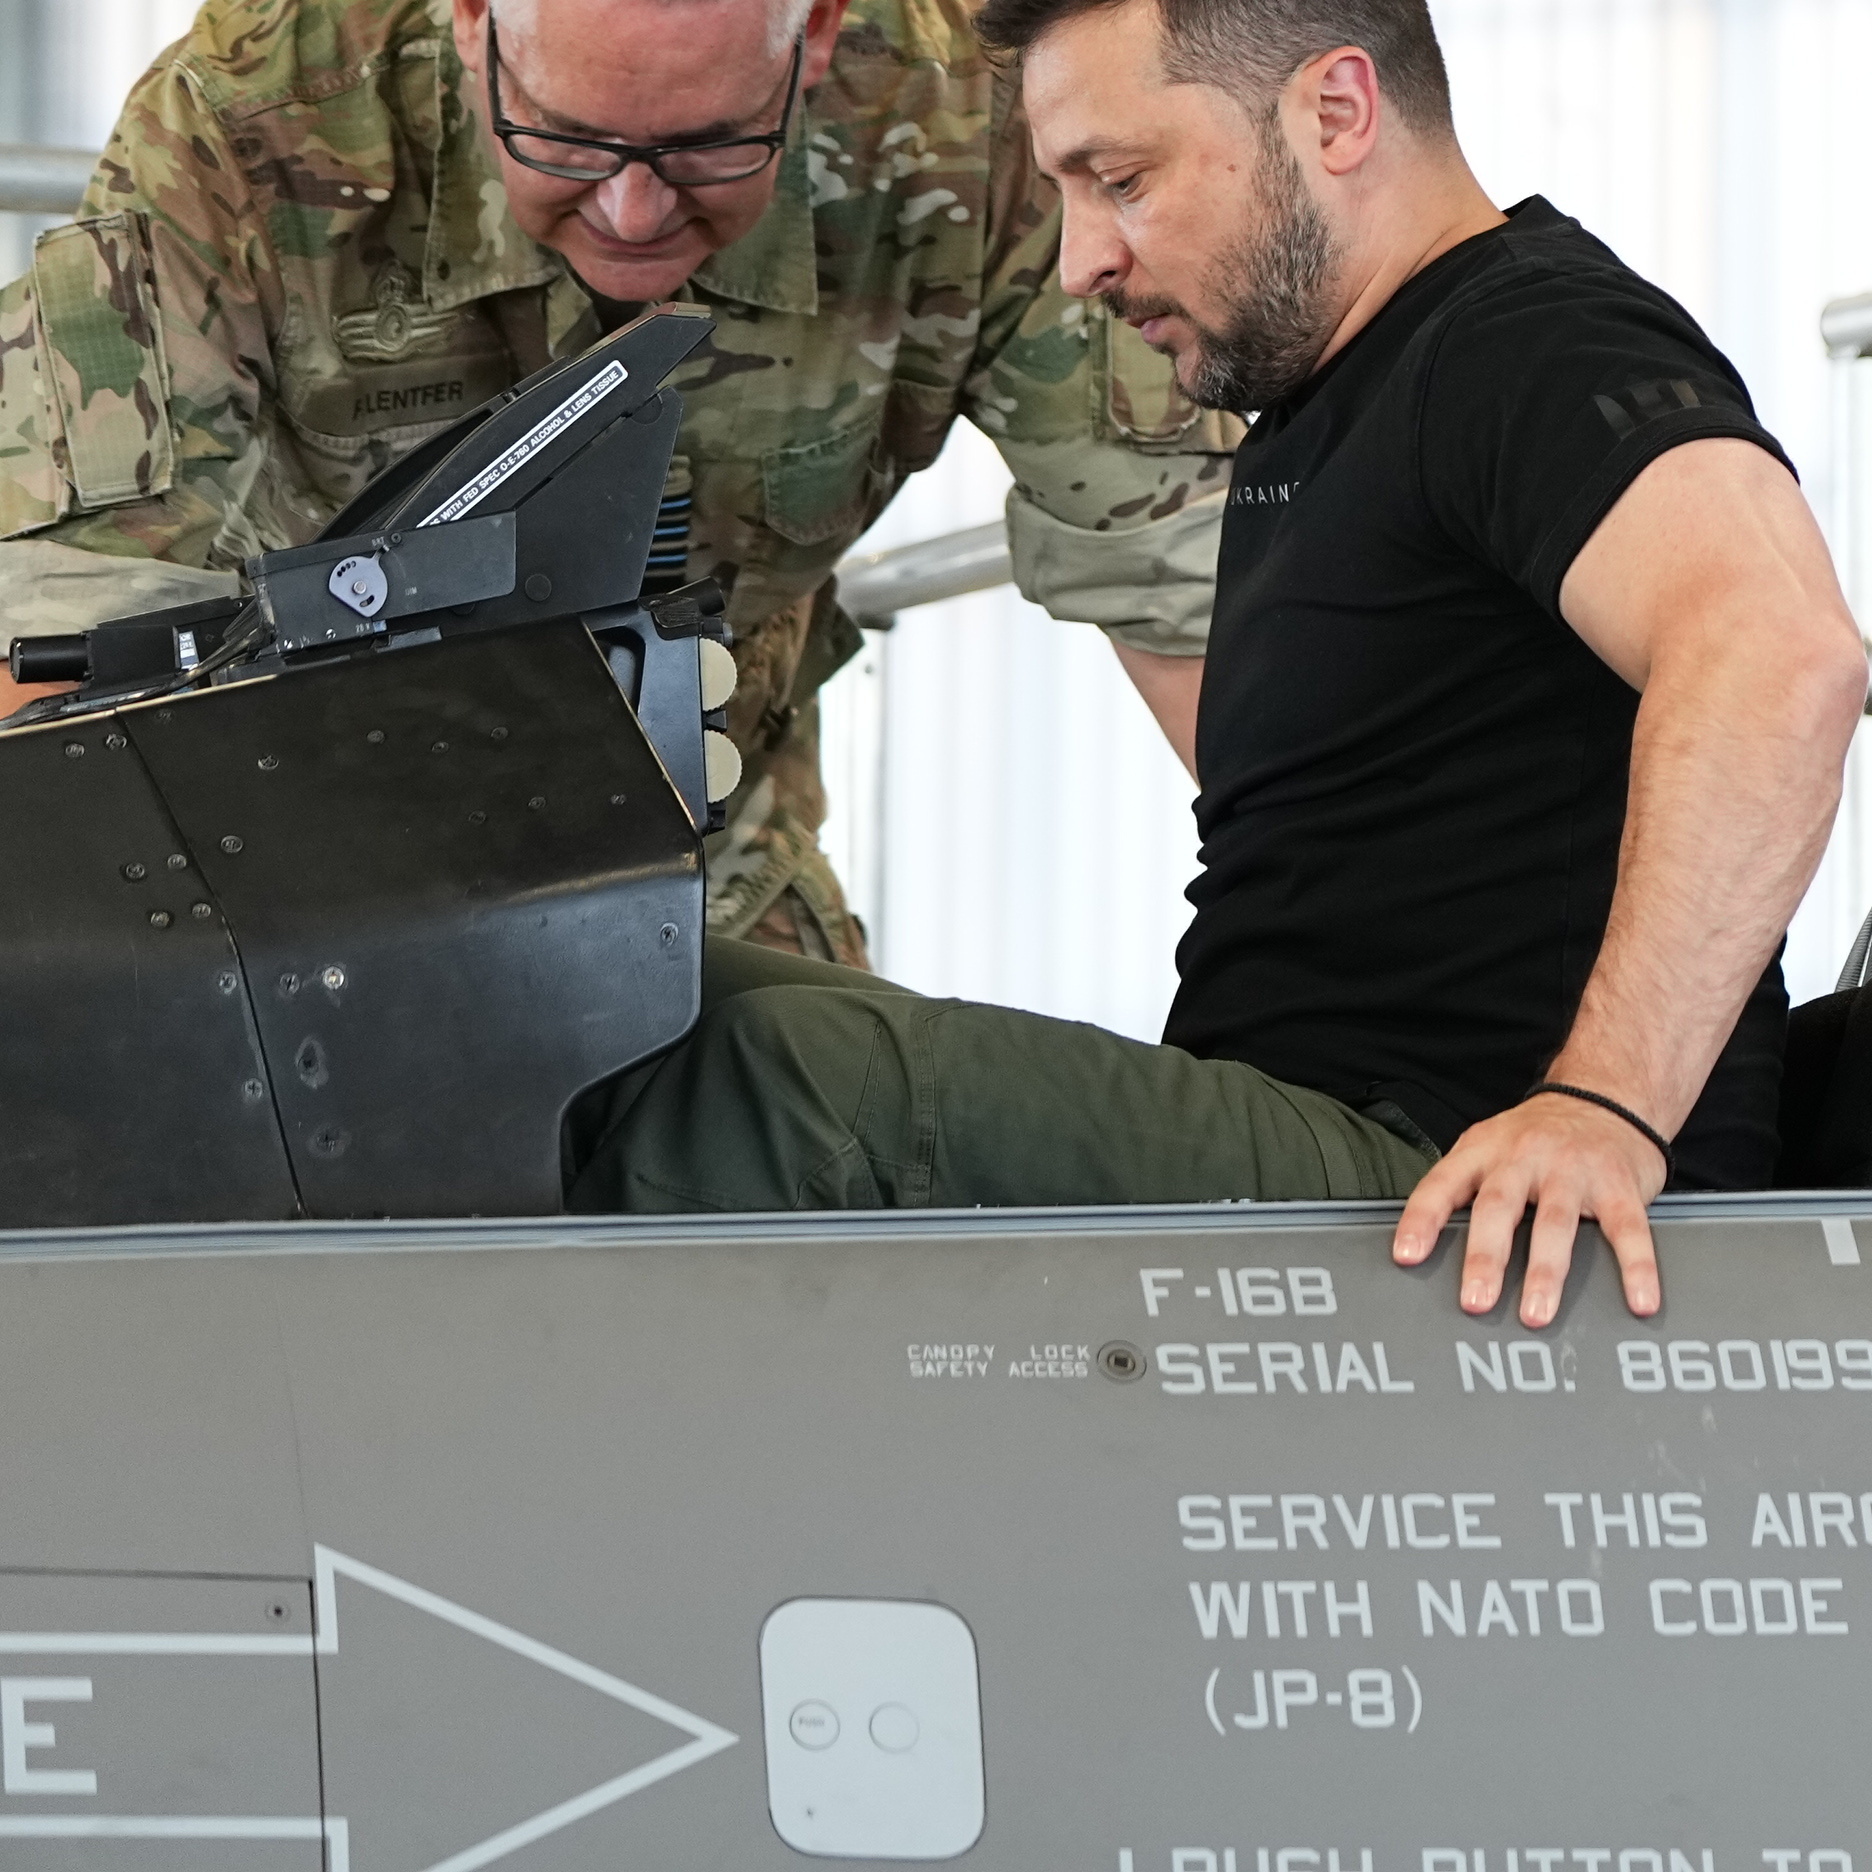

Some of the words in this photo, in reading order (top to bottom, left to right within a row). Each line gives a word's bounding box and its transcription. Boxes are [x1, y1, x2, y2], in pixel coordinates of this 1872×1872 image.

[441, 499, 464, 521] WITH
[462, 486, 479, 503] FED
[478, 469, 500, 490] SPEC
[530, 416, 565, 447] ALCOHOL
[563, 408, 573, 419] &
[571, 392, 592, 412] LENS
[591, 369, 619, 395] TISSUE
[1140, 1267, 1337, 1317] F-16B
[907, 1343, 995, 1361] CANOPY
[1030, 1343, 1091, 1361] LOCK
[910, 1360, 989, 1379] SAFETY
[1009, 1361, 1089, 1379] ACCESS
[1156, 1342, 1414, 1394] SERIAL
[1178, 1493, 1501, 1550] SERVICE
[1544, 1492, 1707, 1548] THIS
[1189, 1580, 1373, 1639] WITH
[1417, 1578, 1604, 1636] NATO
[1649, 1578, 1848, 1635] CODE
[1205, 1665, 1422, 1735] (JP-8)
